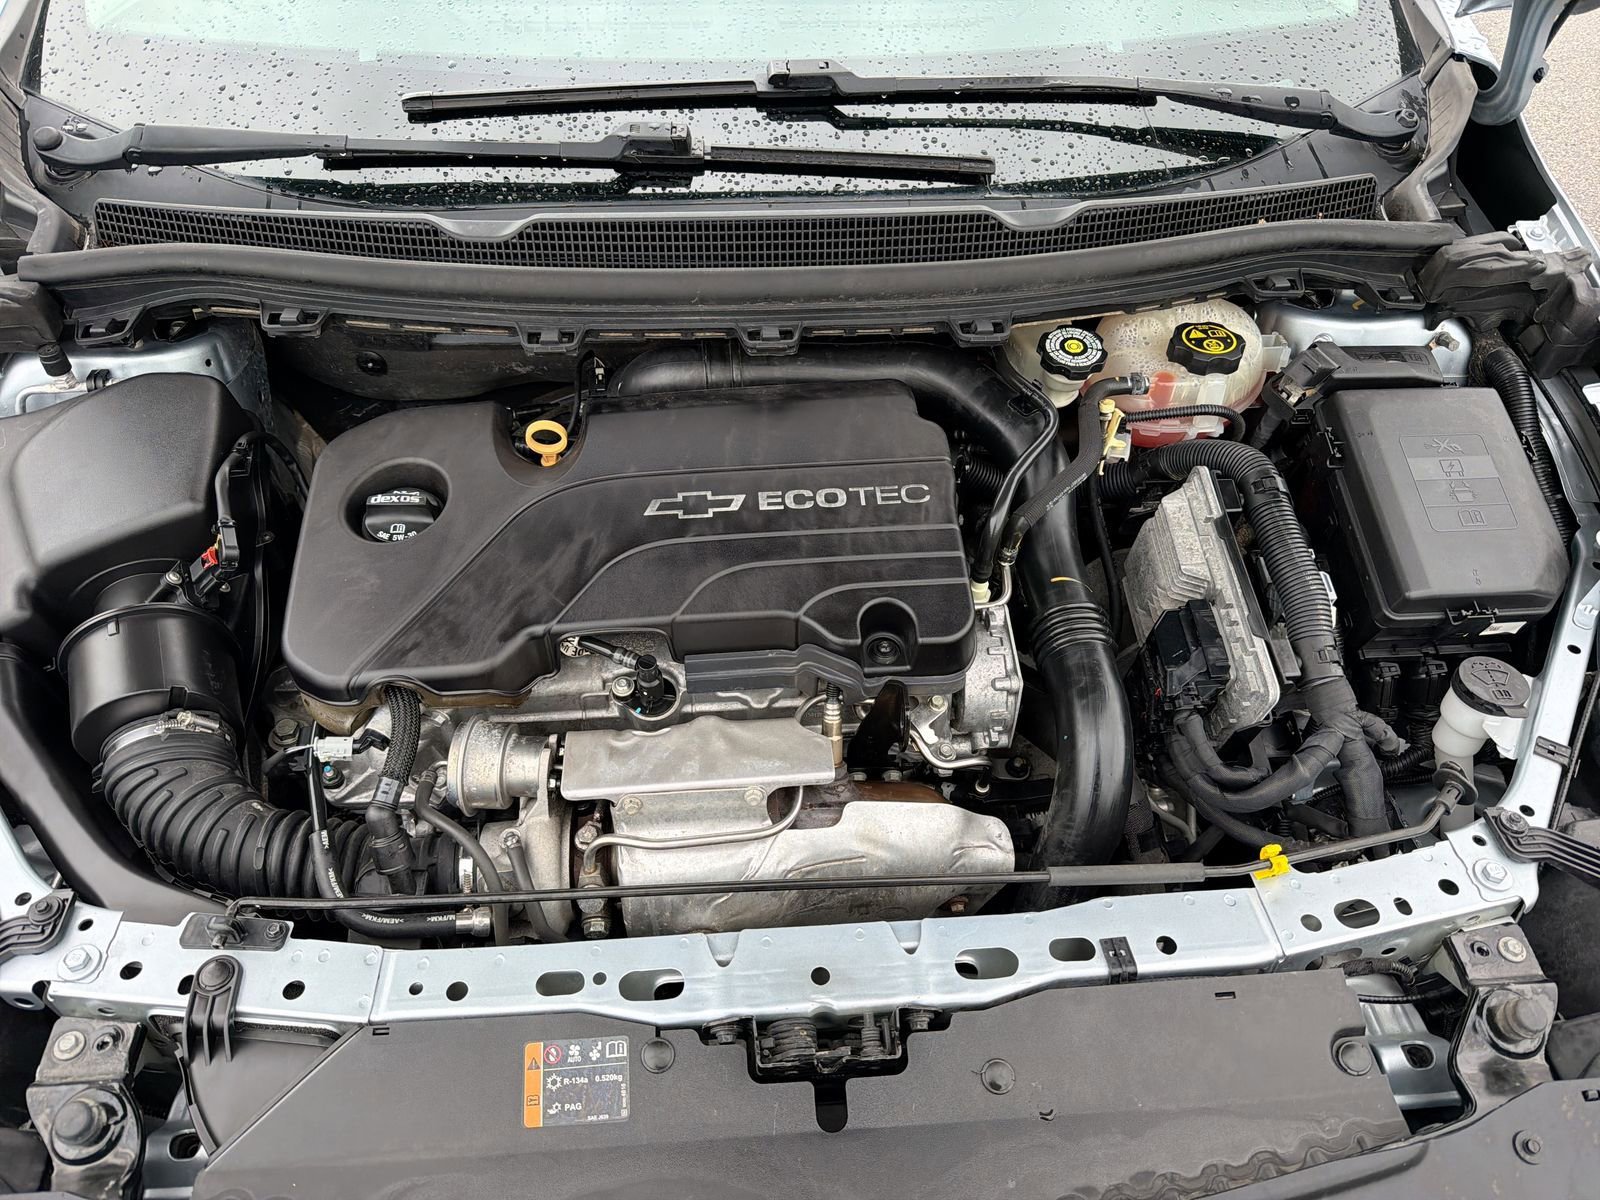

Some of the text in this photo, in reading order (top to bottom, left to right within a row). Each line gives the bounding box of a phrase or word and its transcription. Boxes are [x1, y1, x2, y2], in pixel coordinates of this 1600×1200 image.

[371, 494, 420, 504] dexos
[758, 484, 931, 510] ECOTEC
[377, 531, 390, 540] SAE
[564, 1074, 622, 1085] R-134a 0.520kg
[564, 1103, 582, 1111] PAG
